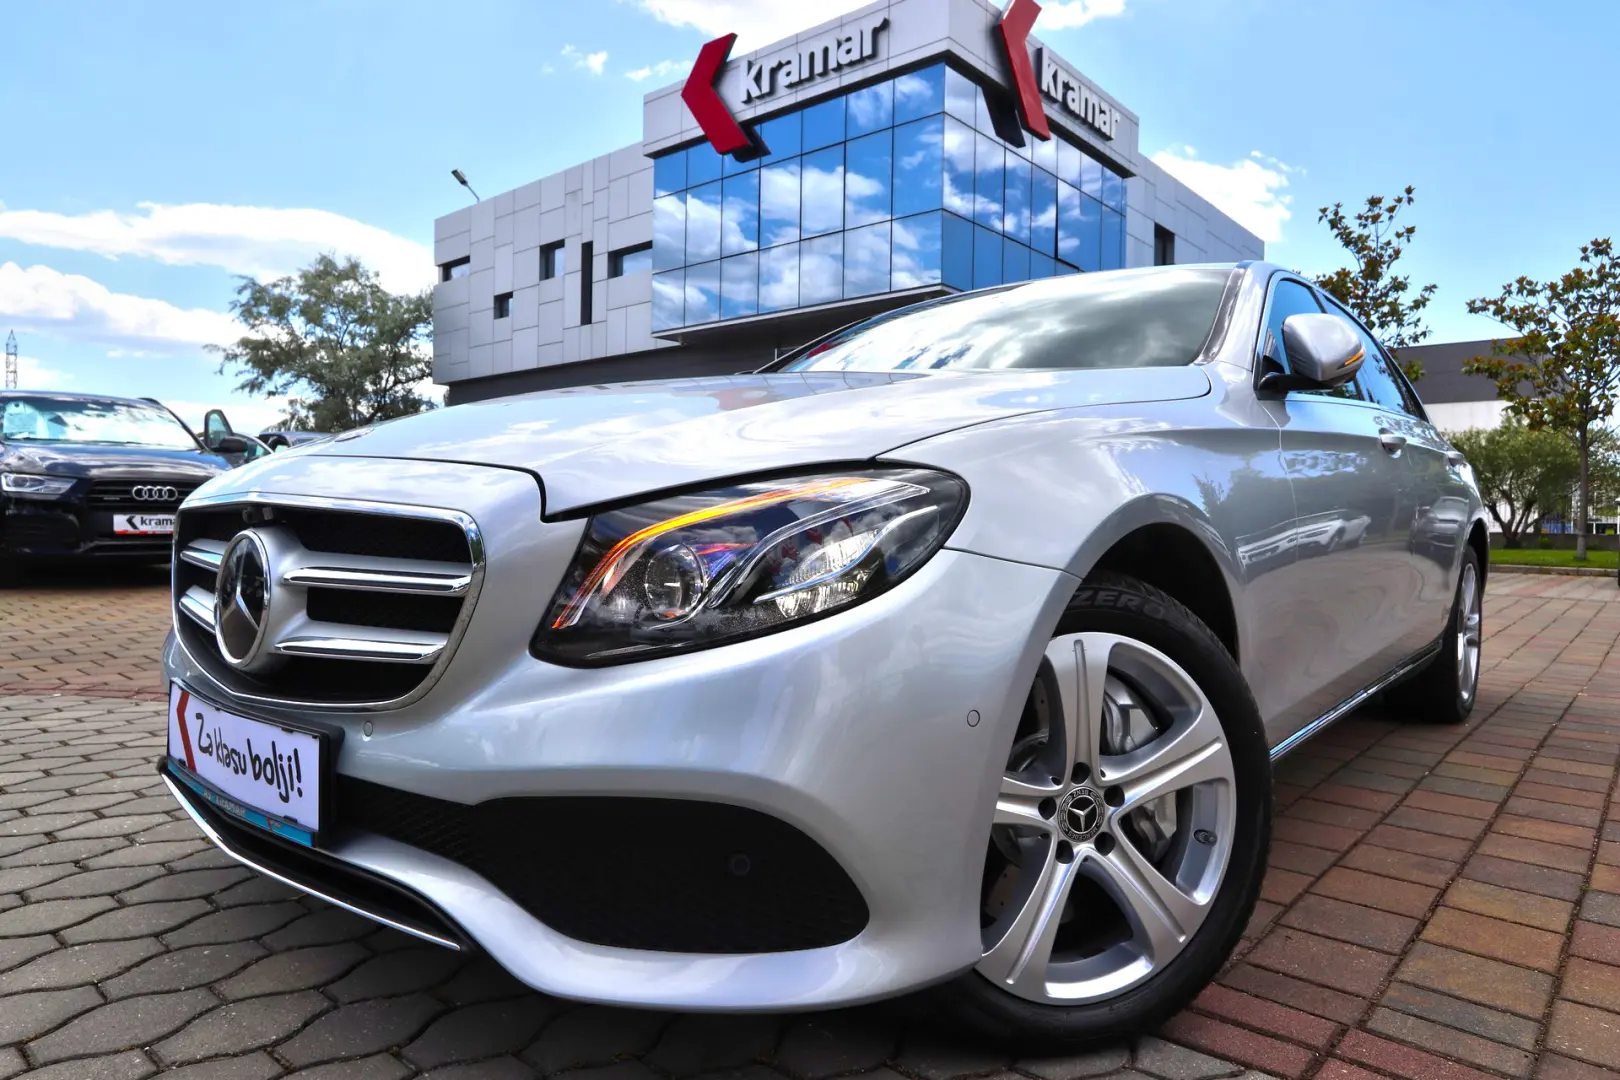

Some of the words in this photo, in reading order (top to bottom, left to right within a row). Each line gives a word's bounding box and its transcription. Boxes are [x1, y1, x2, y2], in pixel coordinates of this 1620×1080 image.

[739, 17, 889, 102] kramar
[1038, 46, 1120, 140] kramar
[1068, 589, 1165, 620] ZERO
[247, 738, 303, 803] bolji!
